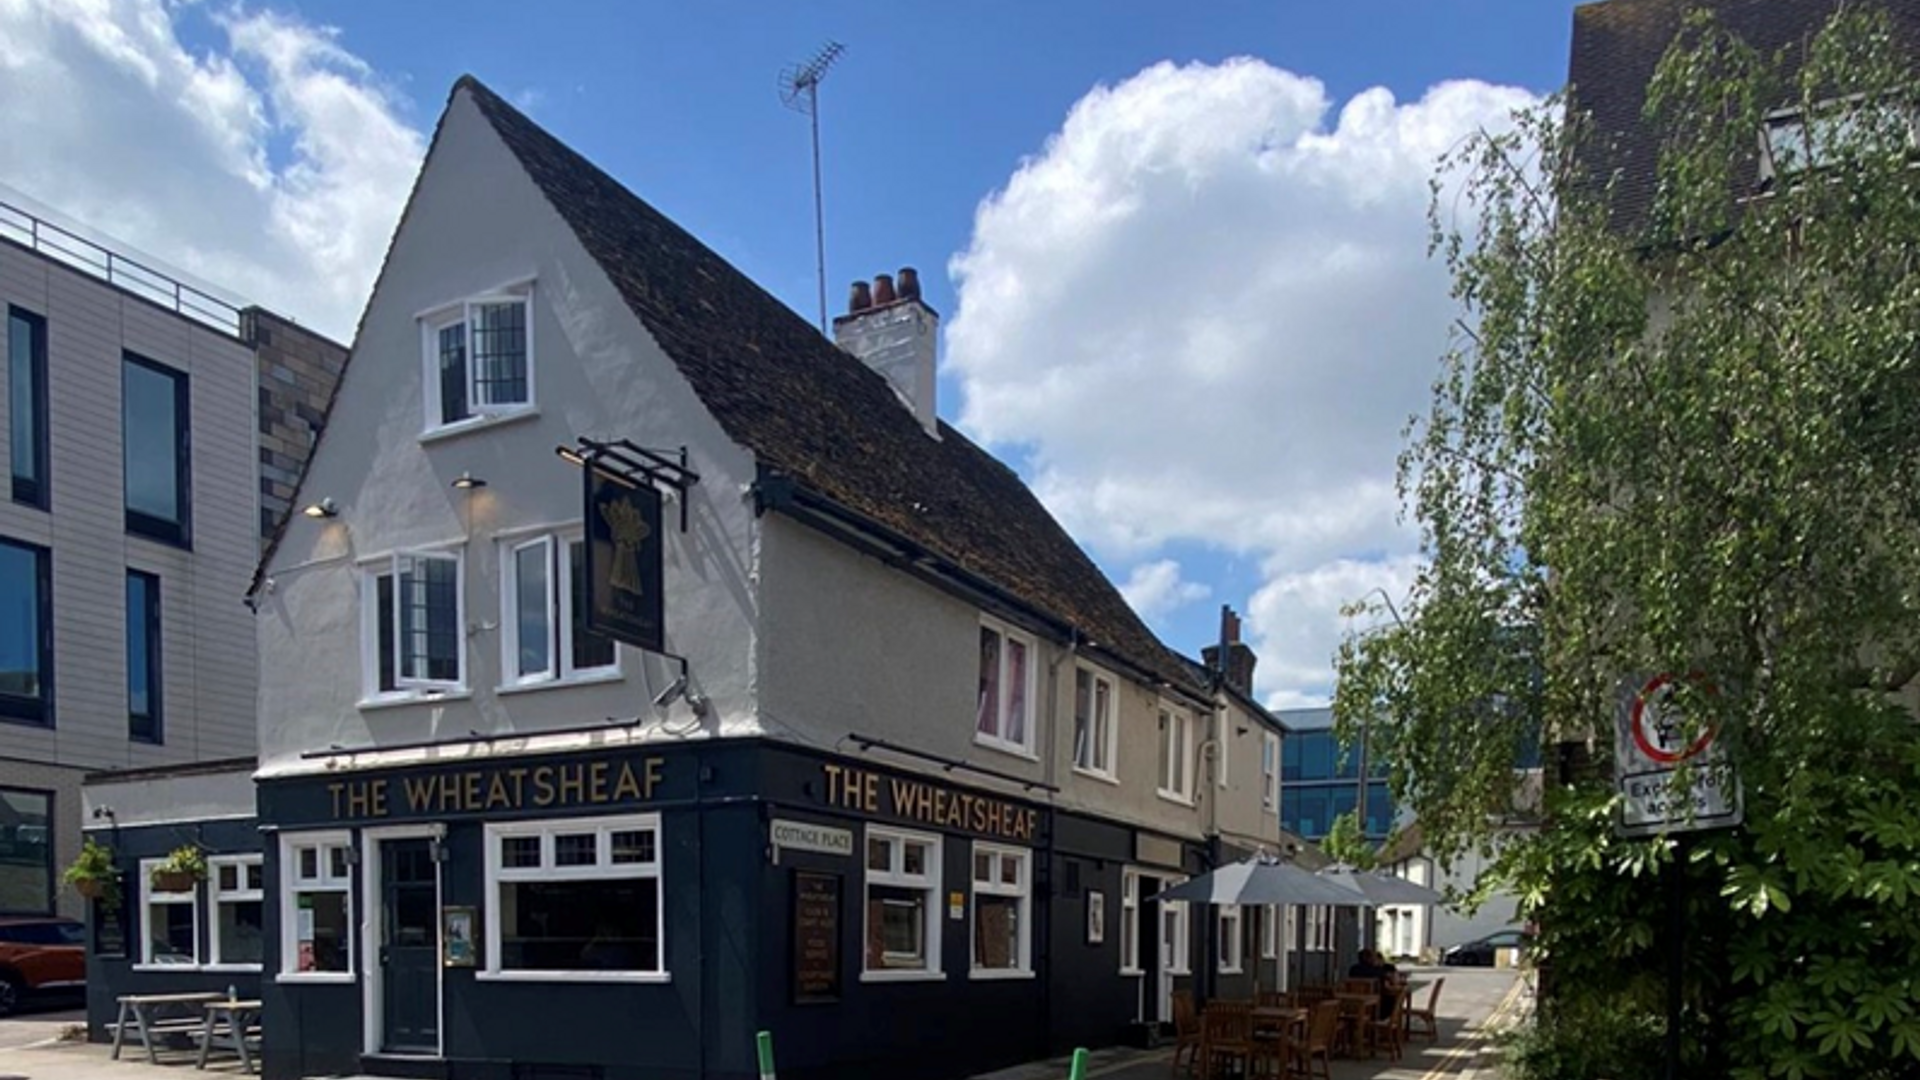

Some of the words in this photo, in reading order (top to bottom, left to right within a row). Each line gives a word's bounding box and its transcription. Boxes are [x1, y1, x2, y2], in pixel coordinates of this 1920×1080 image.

[328, 779, 388, 818] THE
[404, 757, 665, 812] WHEATSHEAF
[825, 764, 879, 811] THE
[892, 779, 1036, 839] WHEATSHEAF
[774, 825, 819, 846] COTTAGE
[822, 832, 850, 850] PLACE
